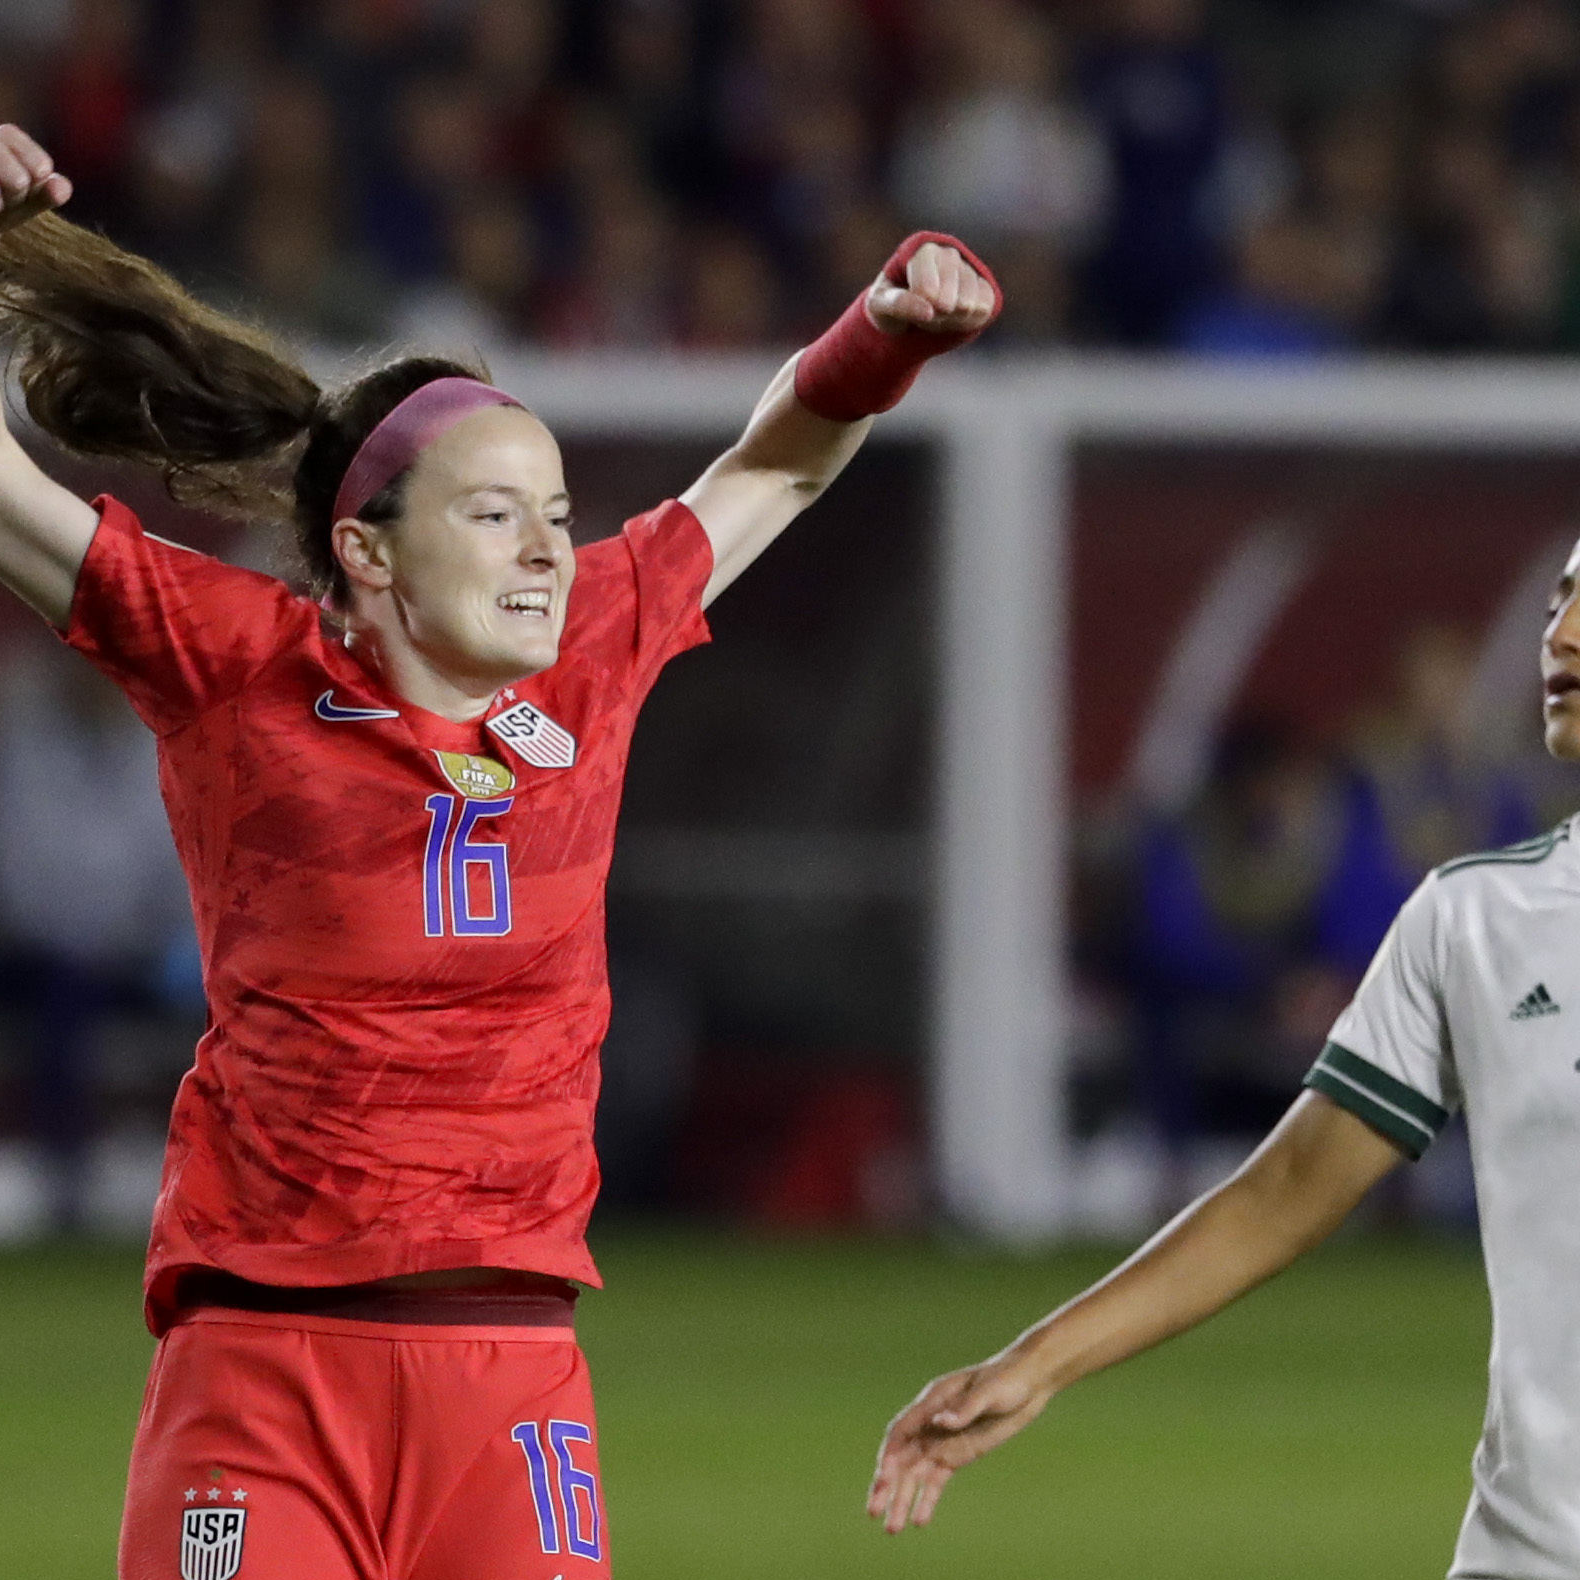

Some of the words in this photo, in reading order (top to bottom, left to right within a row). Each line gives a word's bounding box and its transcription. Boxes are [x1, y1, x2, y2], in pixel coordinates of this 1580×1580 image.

[493, 706, 541, 738] USA
[461, 769, 496, 786] FIFA
[423, 793, 516, 938] 16
[511, 1419, 602, 1563] 16
[187, 1513, 239, 1545] USA
